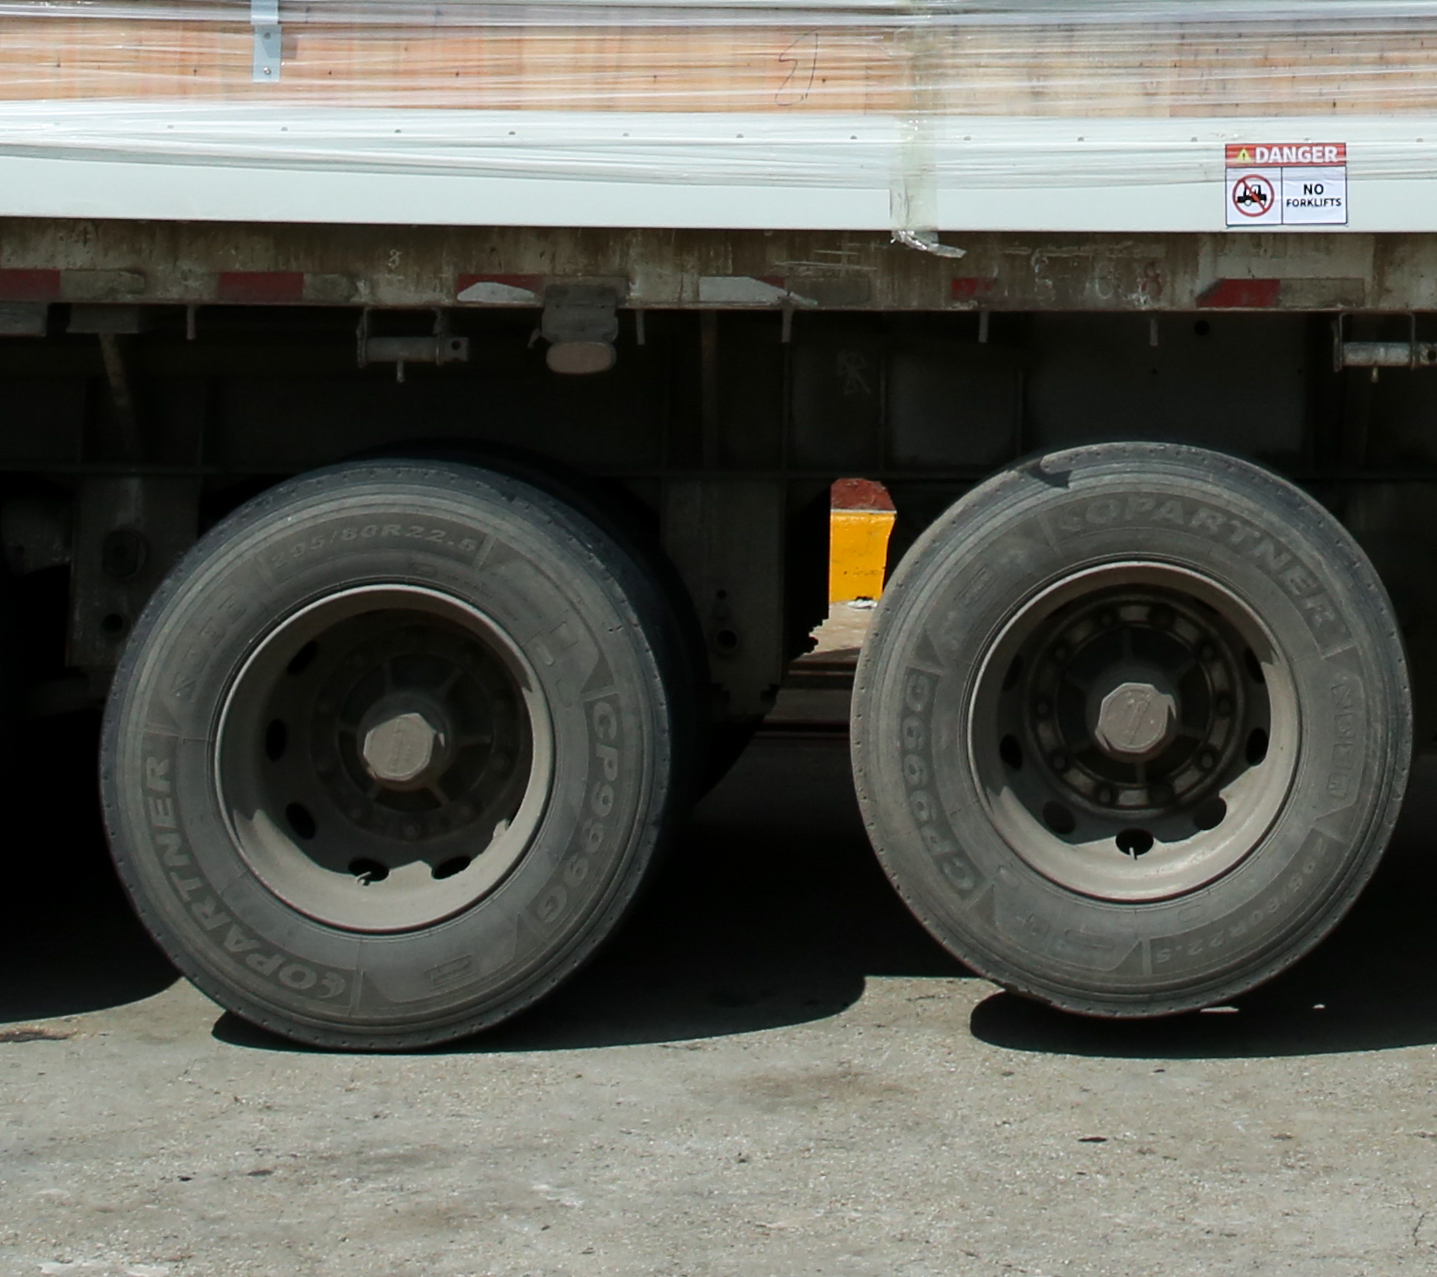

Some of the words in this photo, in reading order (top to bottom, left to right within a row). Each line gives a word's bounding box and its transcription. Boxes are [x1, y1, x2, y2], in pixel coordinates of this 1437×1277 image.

[1255, 146, 1339, 164] DANGER
[1303, 183, 1324, 196] NO
[1285, 197, 1342, 208] FORKLIFTS
[1051, 493, 1341, 633] COPARTNER
[139, 754, 352, 1006] COPARTNER
